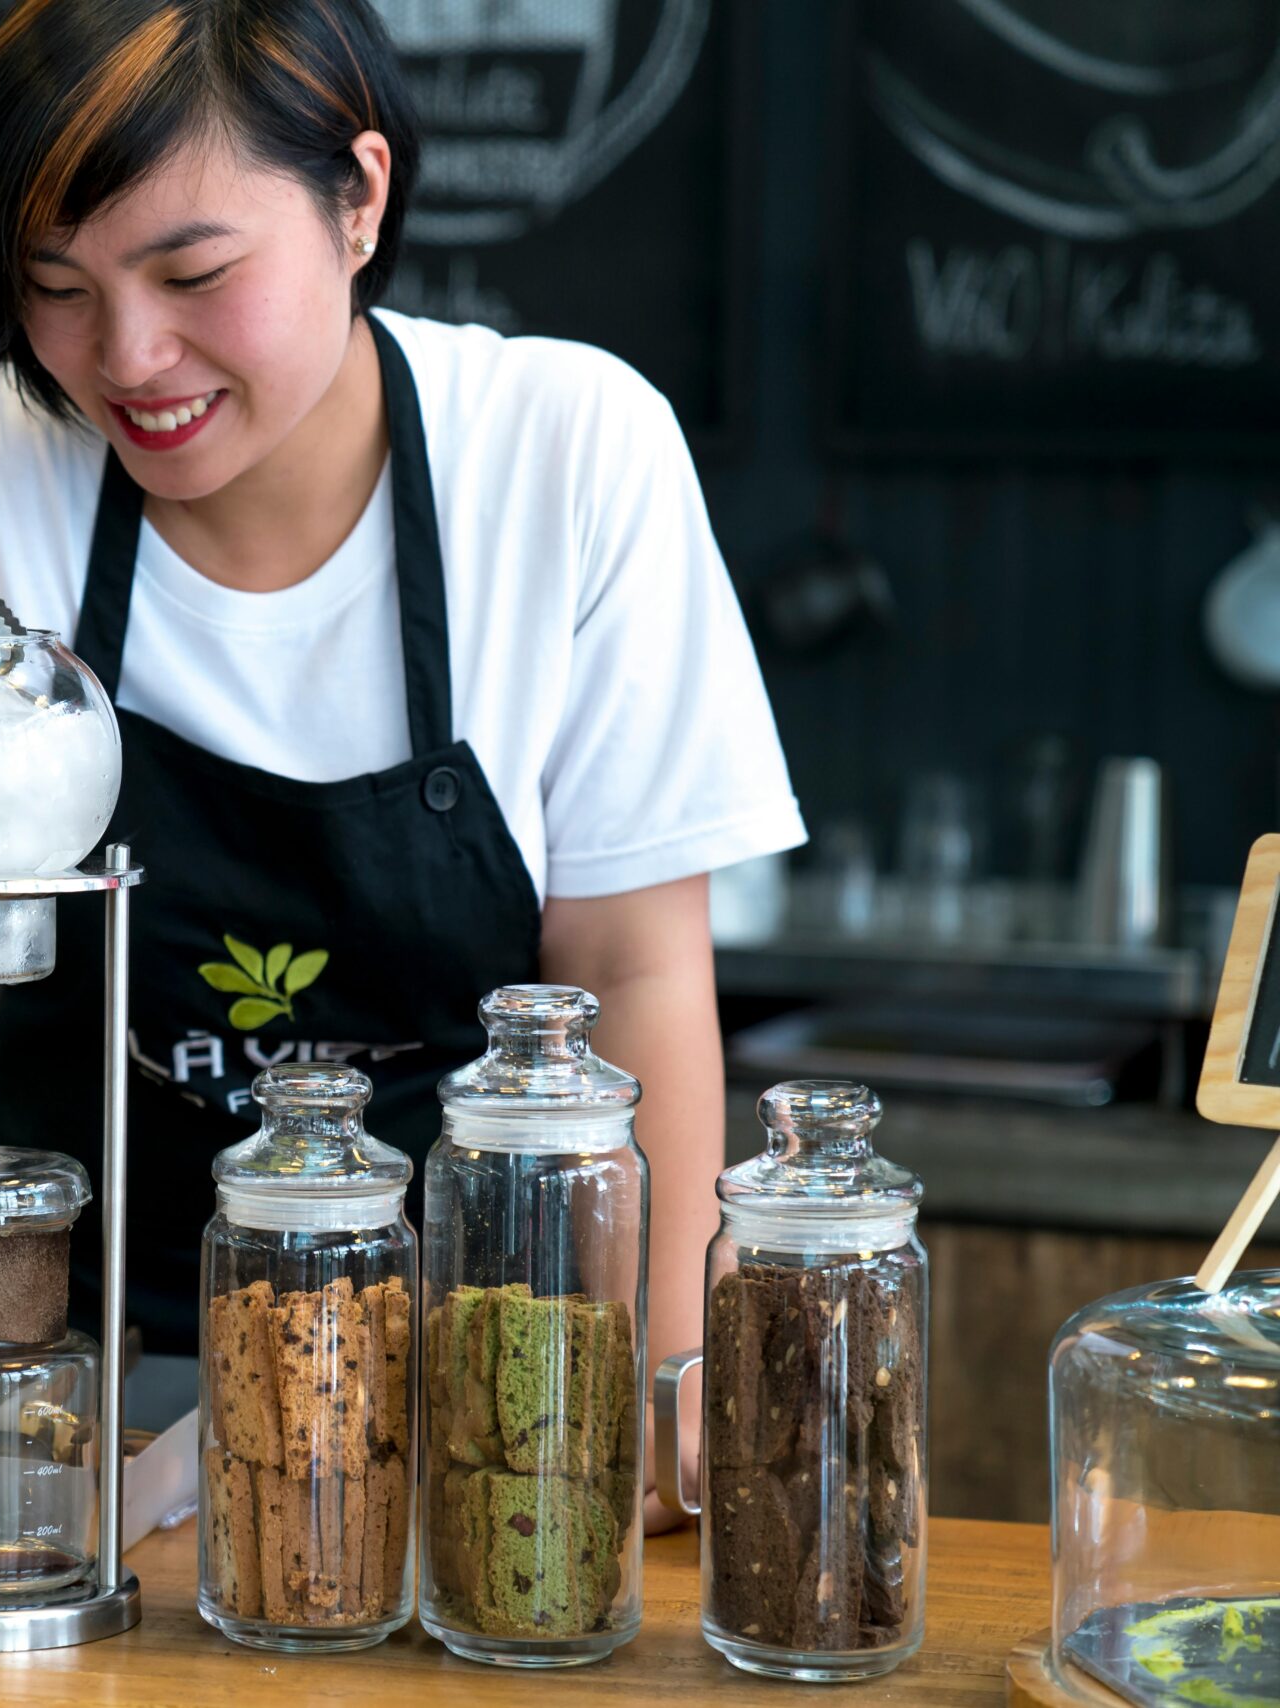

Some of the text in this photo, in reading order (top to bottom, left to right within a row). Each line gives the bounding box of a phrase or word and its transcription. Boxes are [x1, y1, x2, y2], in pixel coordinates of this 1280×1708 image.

[37, 1404, 63, 1417] 600ml
[37, 1464, 63, 1477] 400ml
[36, 1524, 63, 1537] 200ml
